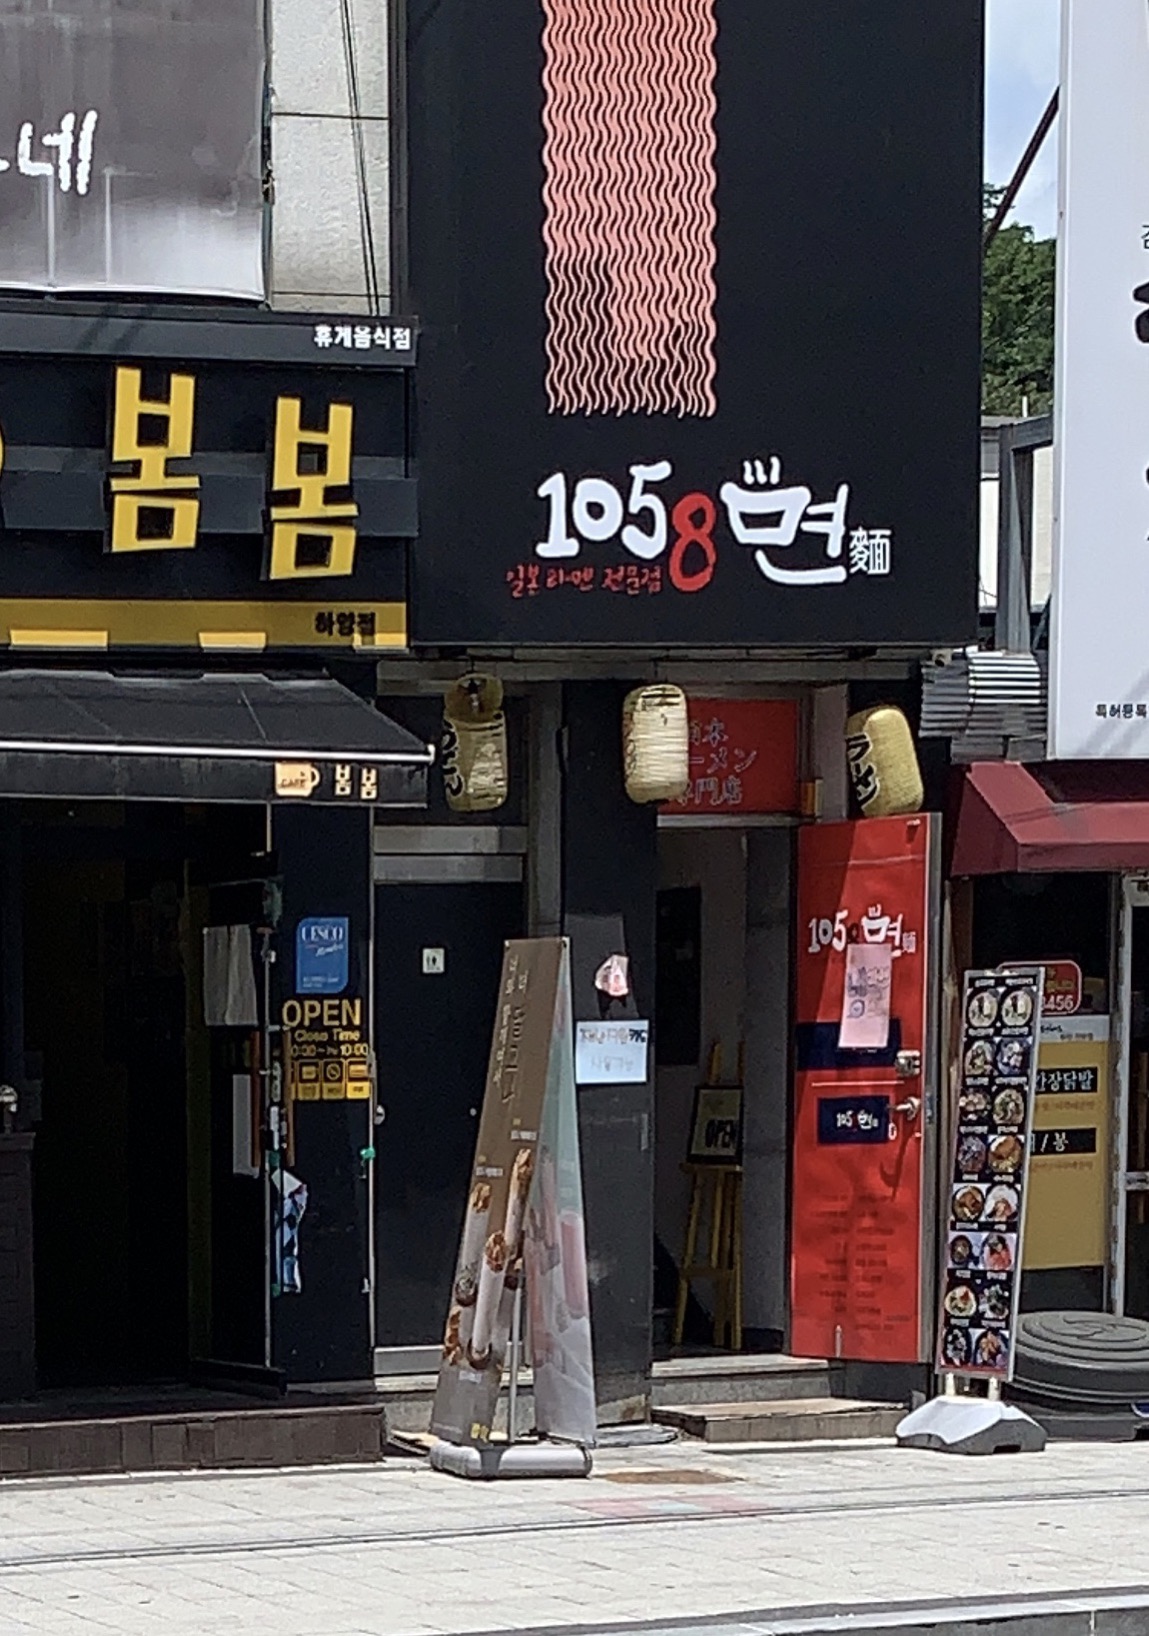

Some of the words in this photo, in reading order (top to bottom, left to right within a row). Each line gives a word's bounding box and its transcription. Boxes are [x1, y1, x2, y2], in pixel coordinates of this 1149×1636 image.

[0, 110, 98, 195] 네
[313, 324, 411, 350] 휴게음식점
[601, 564, 662, 596] 전문점
[282, 999, 362, 1028] OPEN
